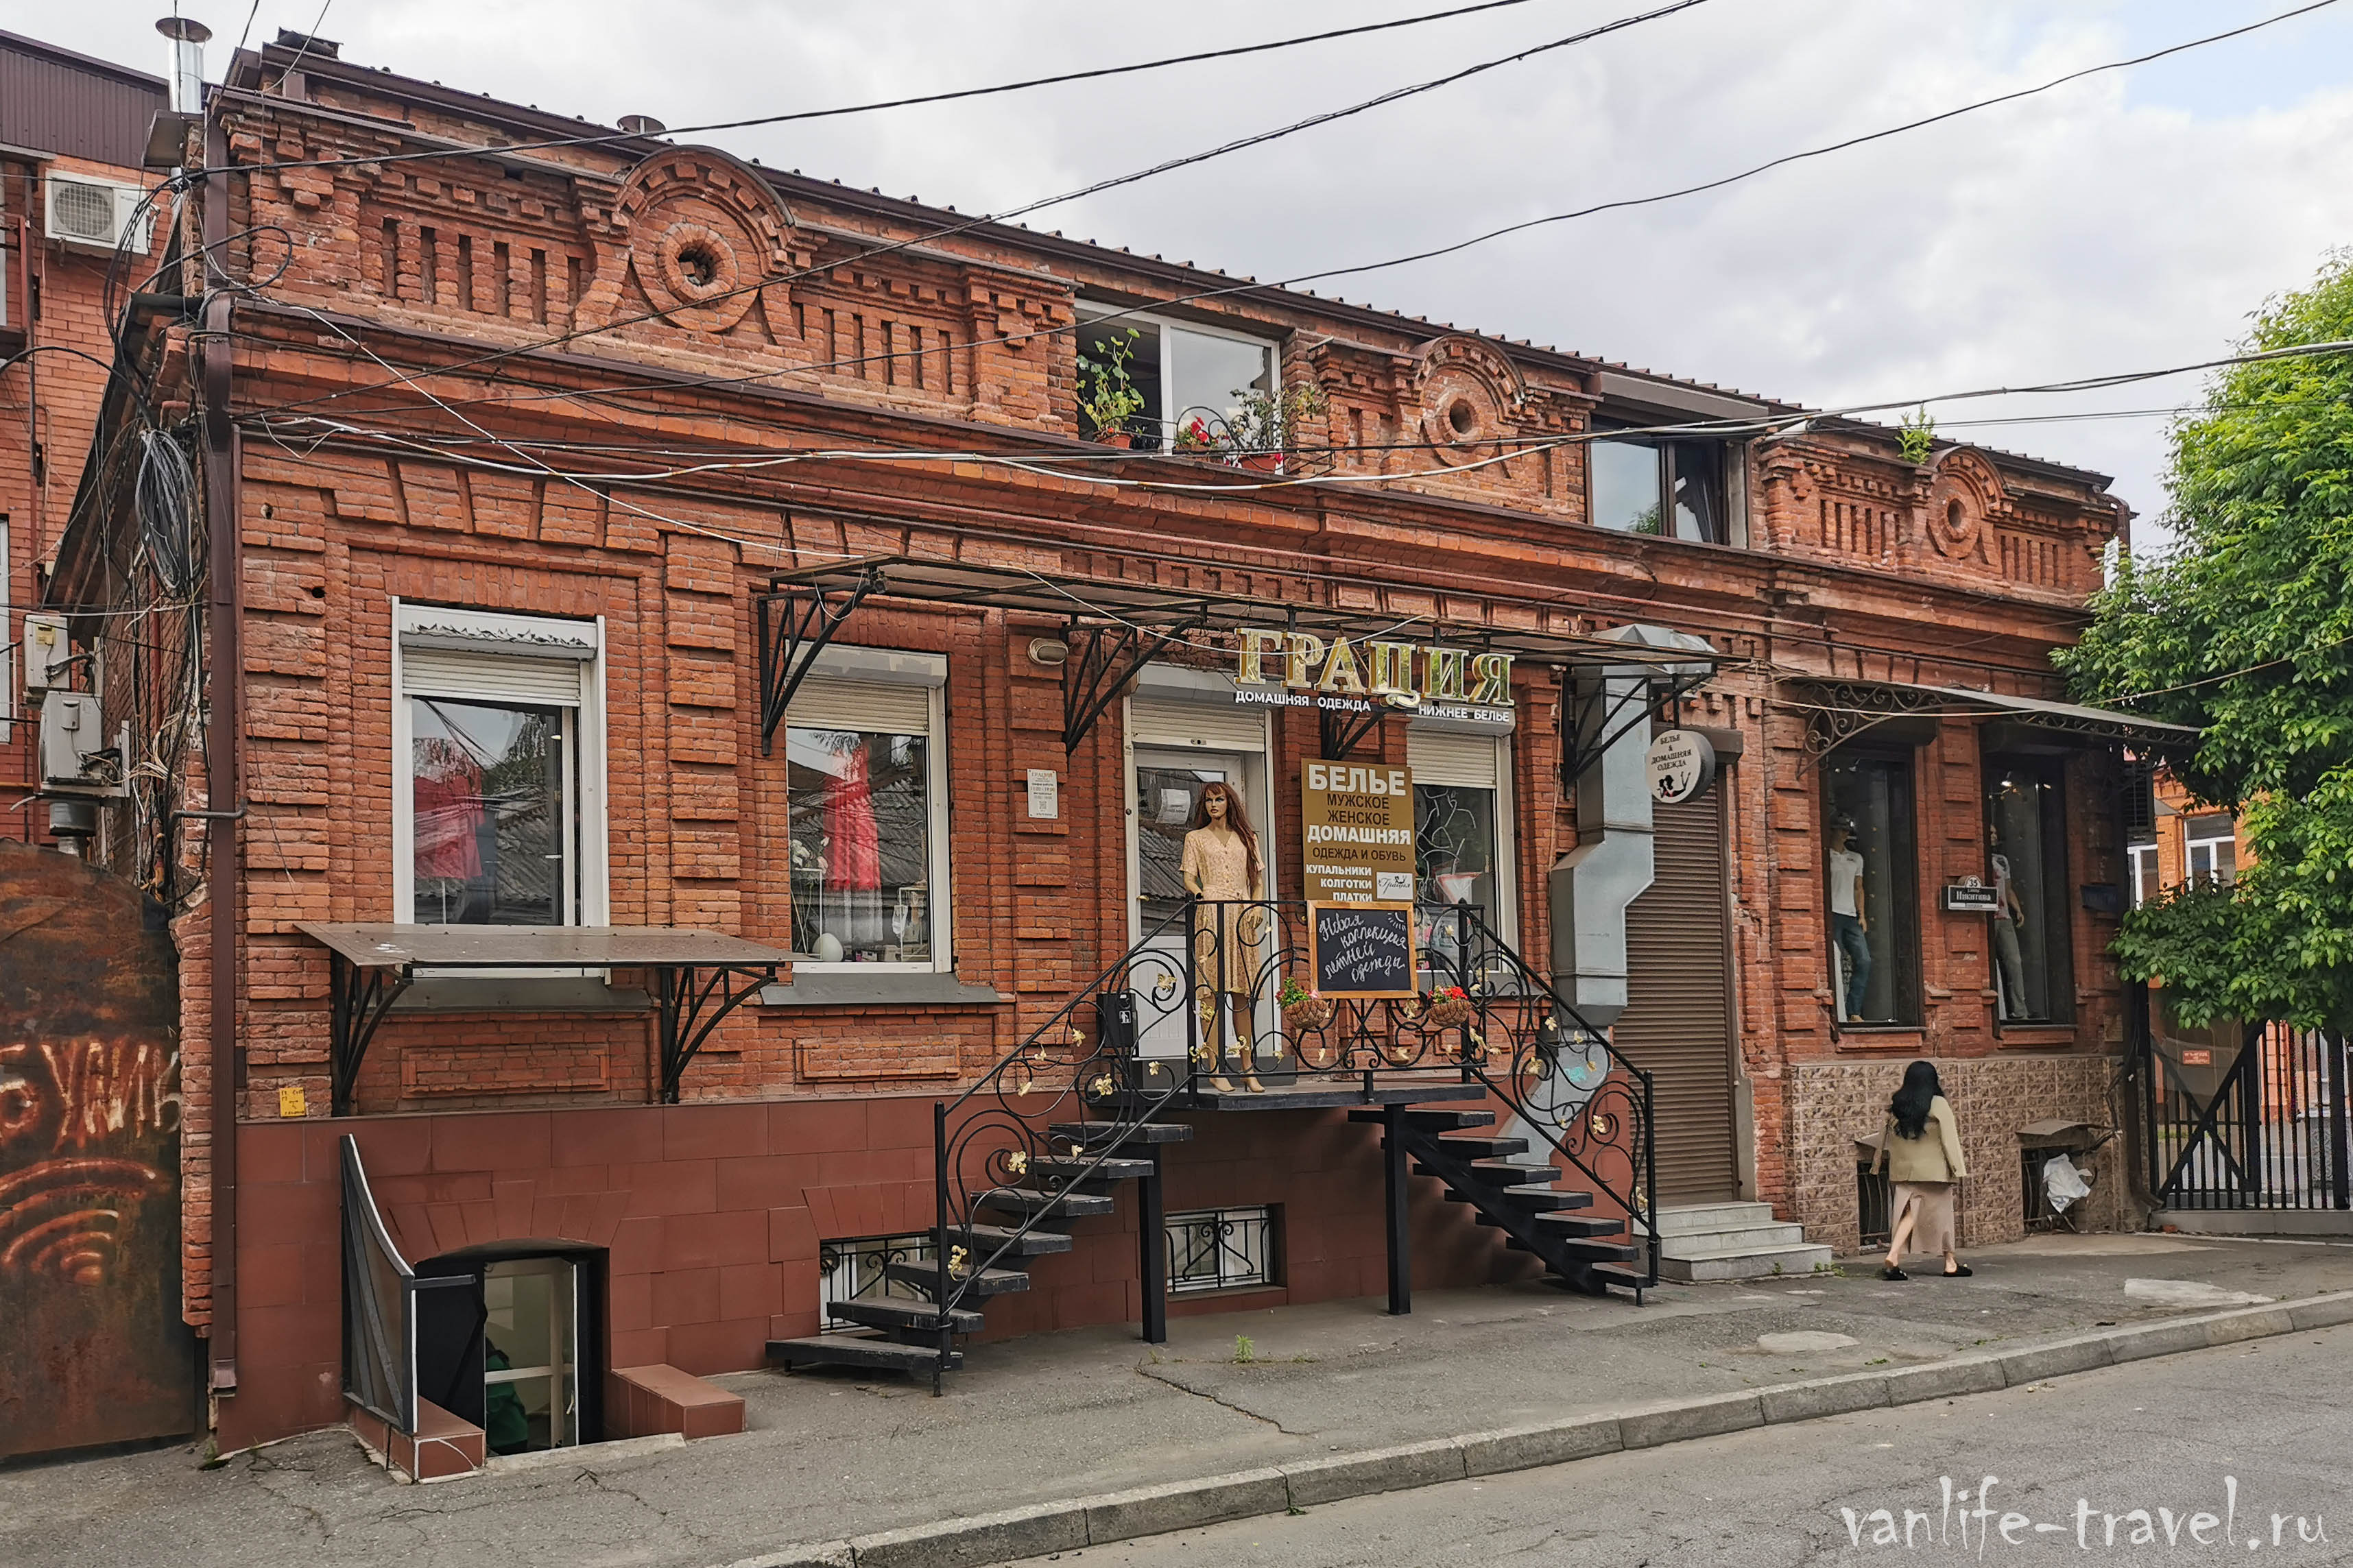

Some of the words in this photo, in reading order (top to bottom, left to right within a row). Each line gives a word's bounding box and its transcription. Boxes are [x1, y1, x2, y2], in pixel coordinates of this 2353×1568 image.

[1234, 627, 1516, 708] ГРАЦИЯ
[1235, 690, 1309, 707] ДОМАШНЯЯ
[1317, 697, 1371, 712] ОДЕЖДА
[1418, 704, 1468, 719] НИЖНЕЕ
[1474, 709, 1509, 722] БЕЛЬЕ
[1309, 764, 1406, 796] БЕЛЬЕ
[1327, 793, 1389, 809] МУЖСКОЕ
[1328, 810, 1390, 825] ЖЕНСКОЕ
[1307, 825, 1411, 845] ДОМАШНЯЯ
[1313, 847, 1358, 861] ОДЕЖДА
[1361, 849, 1368, 860] И
[1371, 850, 1406, 861] ОБУВЬ
[1306, 864, 1372, 876] КУПАЛЬНИКИ
[1321, 878, 1372, 889] КОЛГОТКИ
[1333, 892, 1372, 902] ПЛАТКИ
[1319, 913, 1365, 941] Новая
[1324, 941, 1376, 980] летней
